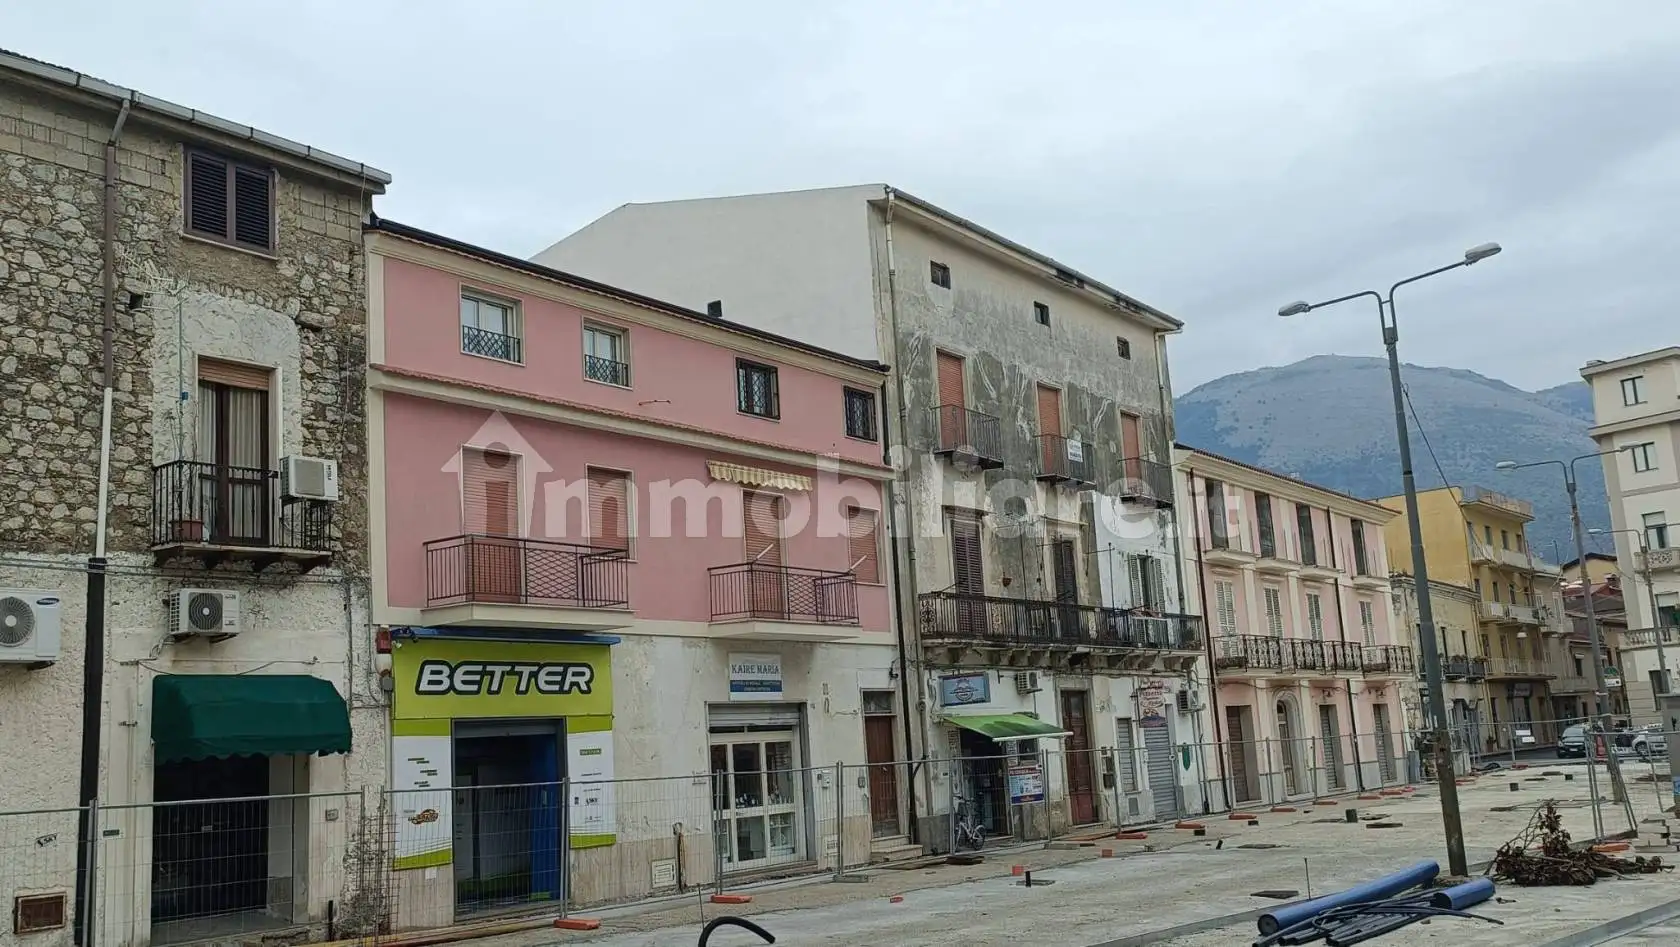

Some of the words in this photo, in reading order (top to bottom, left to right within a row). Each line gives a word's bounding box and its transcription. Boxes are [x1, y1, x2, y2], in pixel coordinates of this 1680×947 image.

[416, 661, 594, 695] BETTER
[731, 664, 756, 674] KAIRE
[757, 664, 780, 675] MARIA
